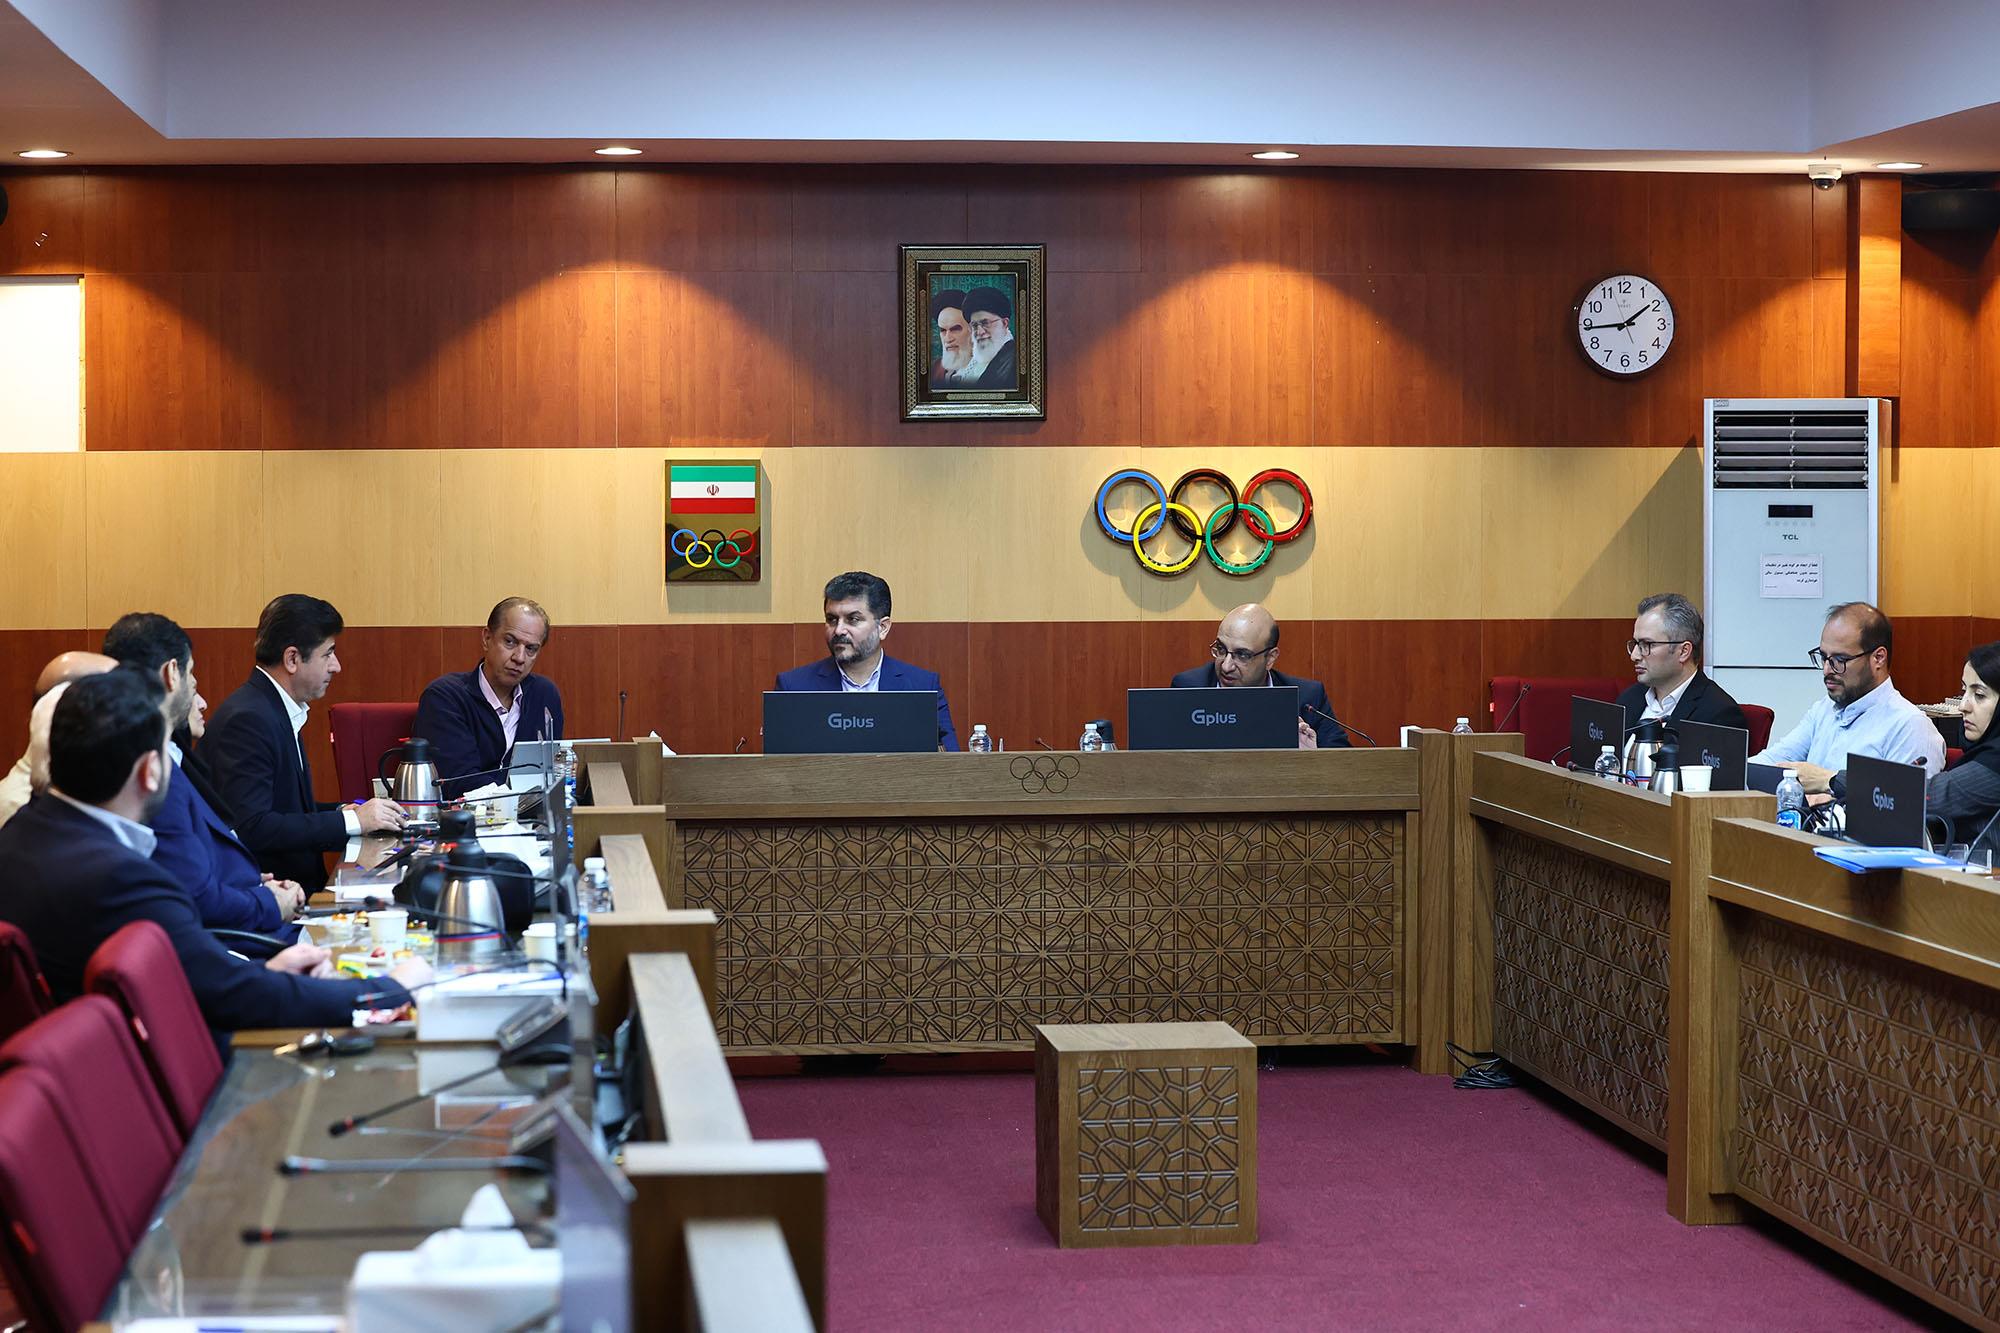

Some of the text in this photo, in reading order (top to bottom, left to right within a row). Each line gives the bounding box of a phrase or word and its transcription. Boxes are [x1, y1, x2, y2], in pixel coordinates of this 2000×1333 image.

[1601, 287, 1613, 299] 11
[1618, 281, 1631, 294] 12
[1640, 287, 1645, 299] 1
[1588, 301, 1602, 313] 10
[1651, 300, 1661, 312] 2
[1583, 318, 1593, 331] 9
[1657, 318, 1667, 331] 3
[1590, 337, 1600, 349] 8
[1651, 337, 1661, 349] 4
[1604, 350, 1613, 362] 7
[1620, 355, 1630, 368] 6
[1638, 351, 1648, 363] 5
[828, 713, 874, 730] Gplus
[1191, 709, 1237, 727] Gplus
[1588, 722, 1604, 741] Gplus
[1701, 748, 1721, 769] Gplus
[1872, 786, 1895, 811] Gplus
